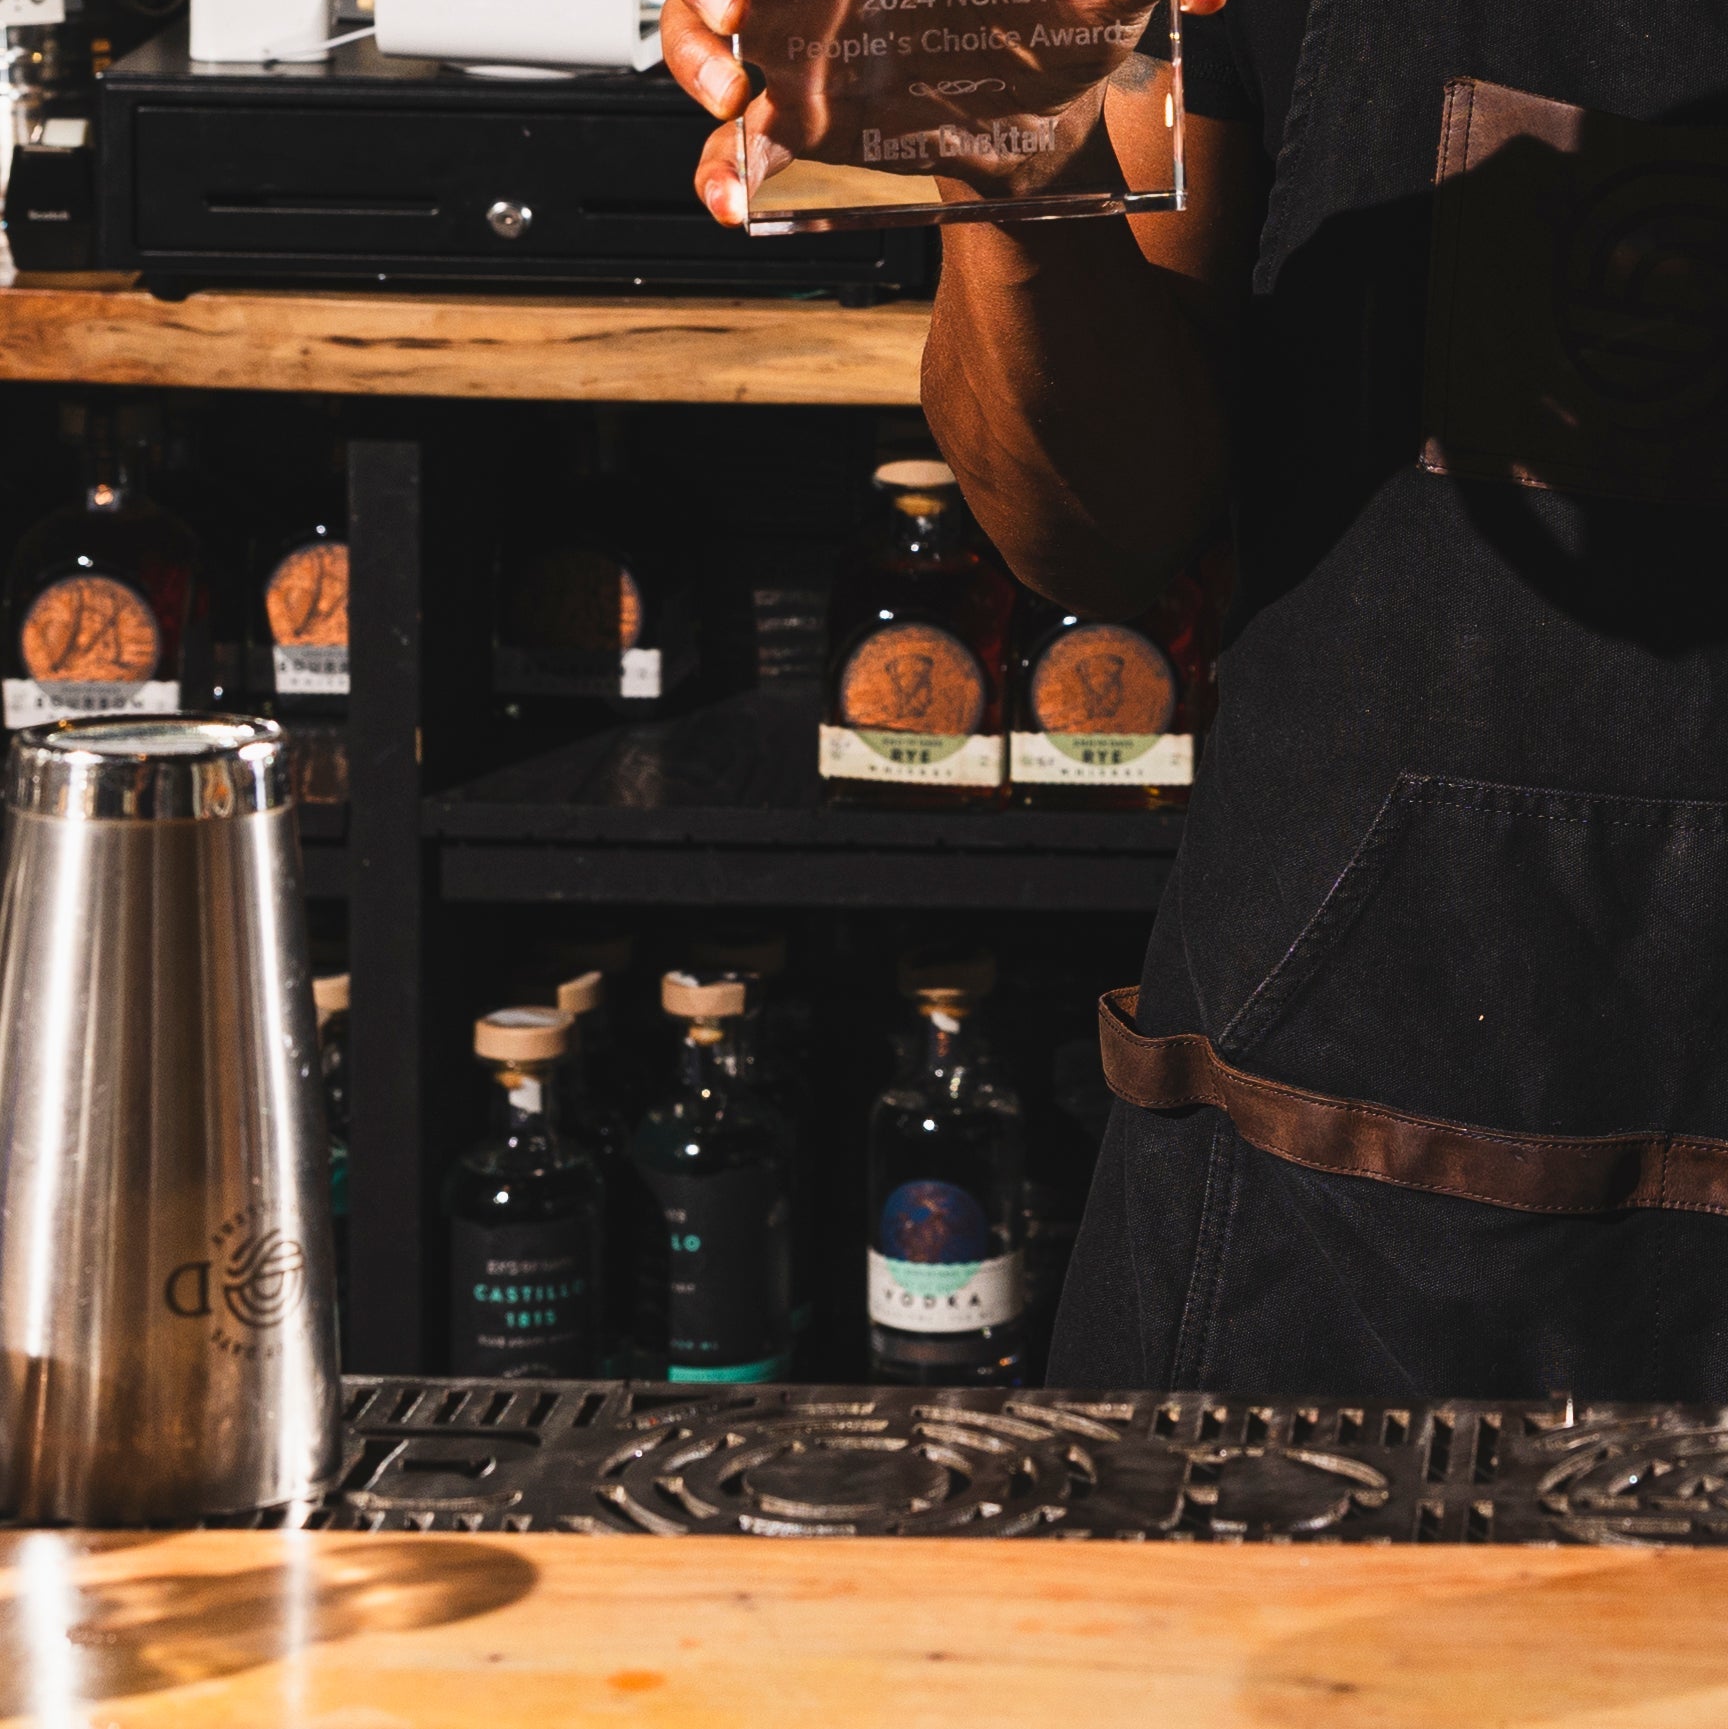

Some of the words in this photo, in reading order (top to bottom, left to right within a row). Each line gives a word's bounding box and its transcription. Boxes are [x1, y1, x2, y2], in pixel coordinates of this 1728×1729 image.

[787, 29, 912, 63] People's
[920, 25, 1022, 54] Choice
[863, 127, 931, 163] Best
[939, 119, 1056, 158] Cocktail
[890, 748, 931, 765] RYE
[1082, 748, 1122, 765] RYE
[885, 1288, 981, 1309] VODKA
